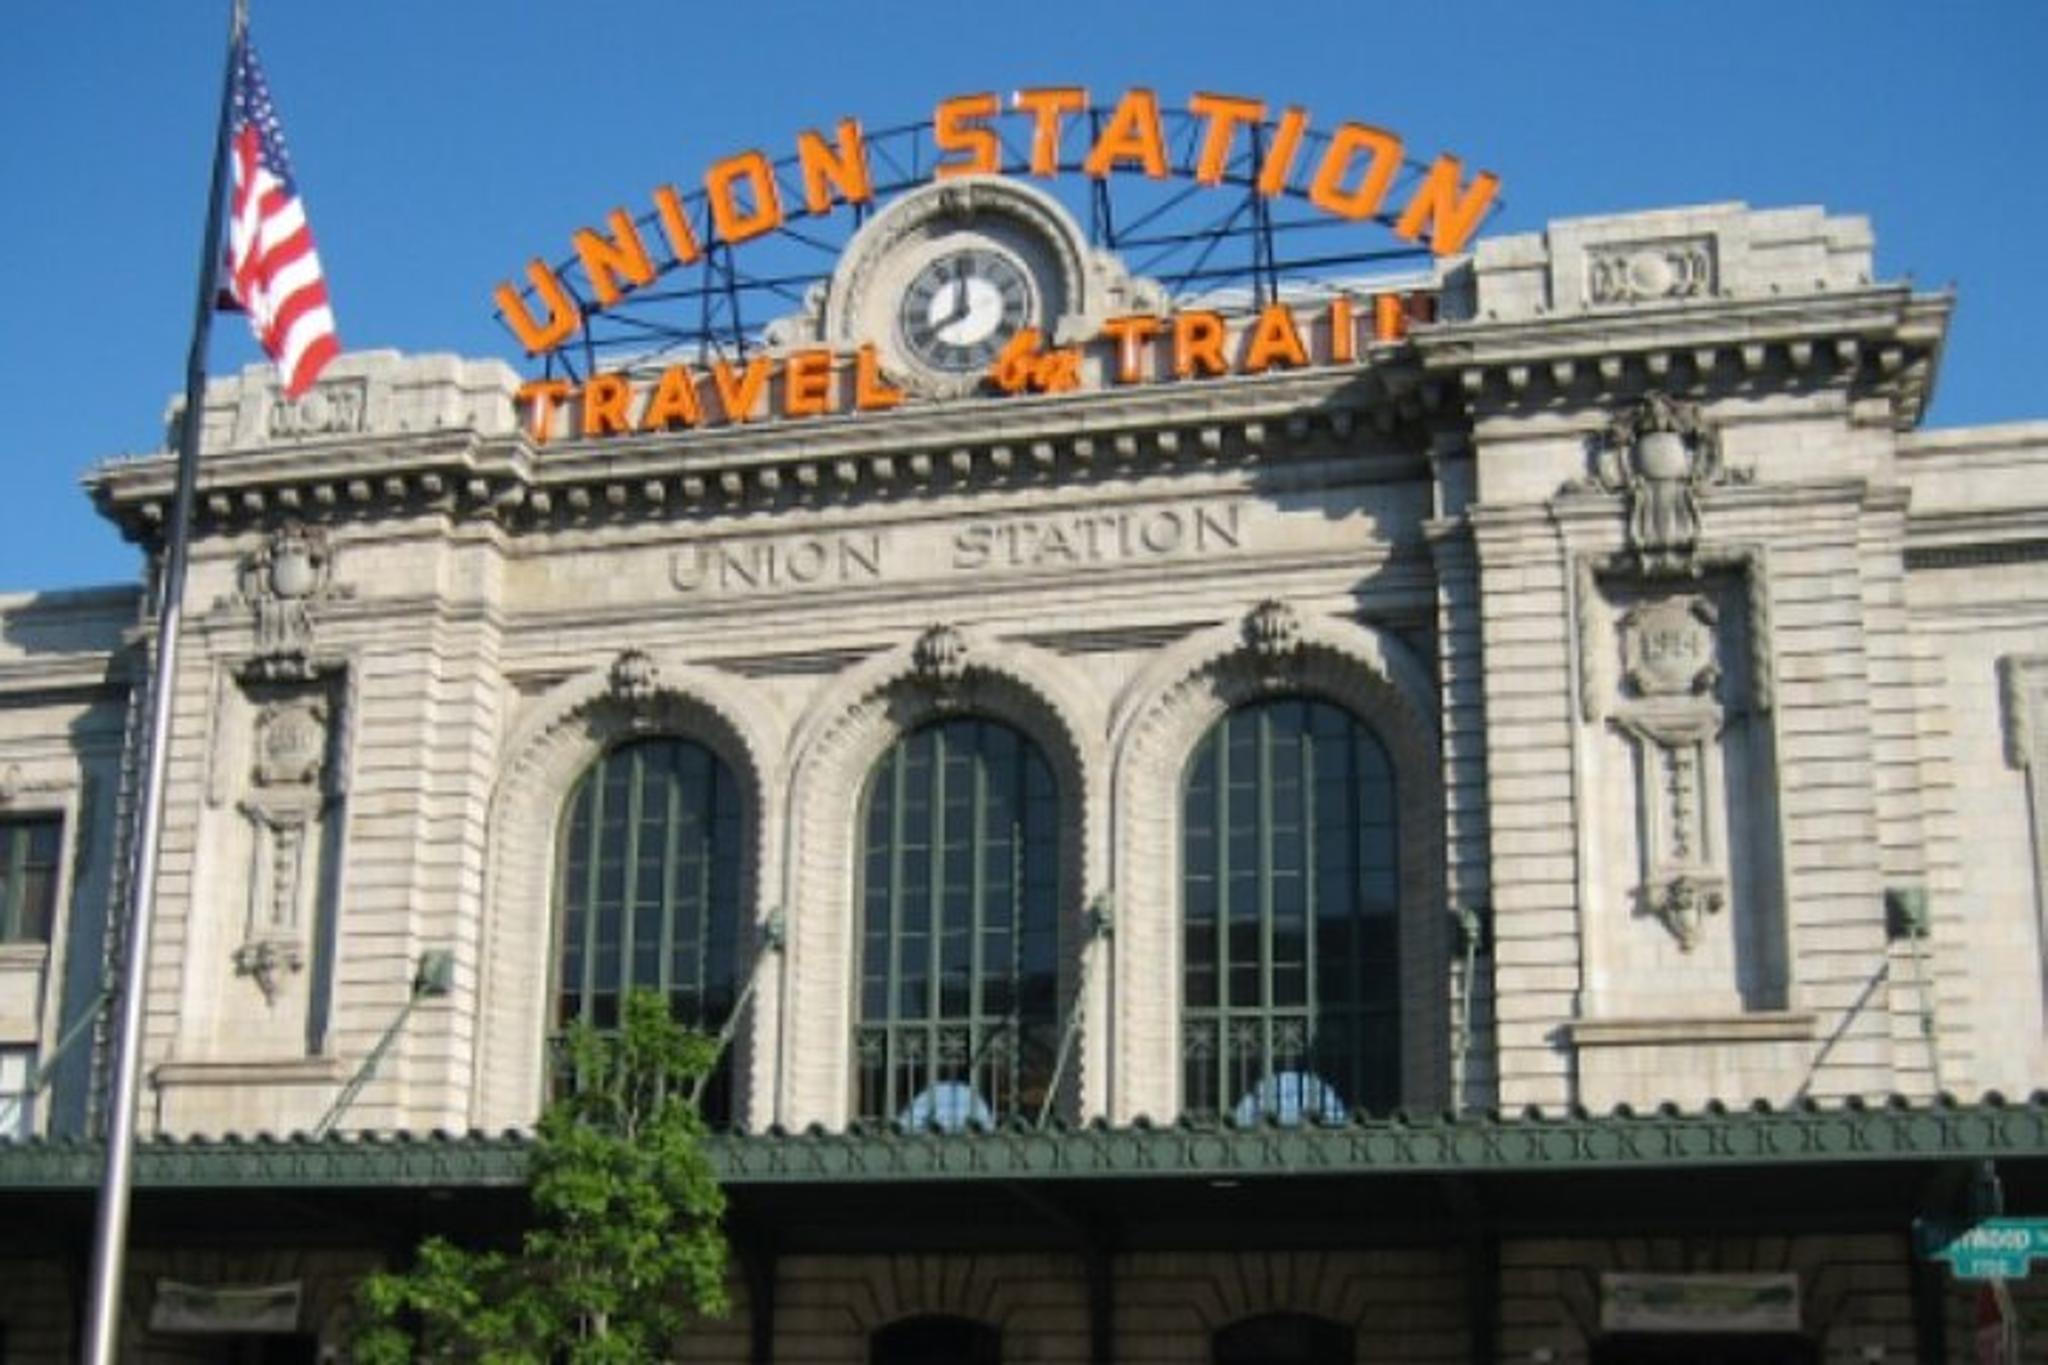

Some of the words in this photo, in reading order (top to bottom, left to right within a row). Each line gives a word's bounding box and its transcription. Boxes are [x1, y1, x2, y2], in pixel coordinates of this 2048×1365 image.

[494, 116, 873, 355] UNION
[933, 87, 1501, 257] STATION
[515, 342, 908, 445] TRAVEL
[666, 533, 882, 592] UNION
[952, 504, 1240, 571] STATION
